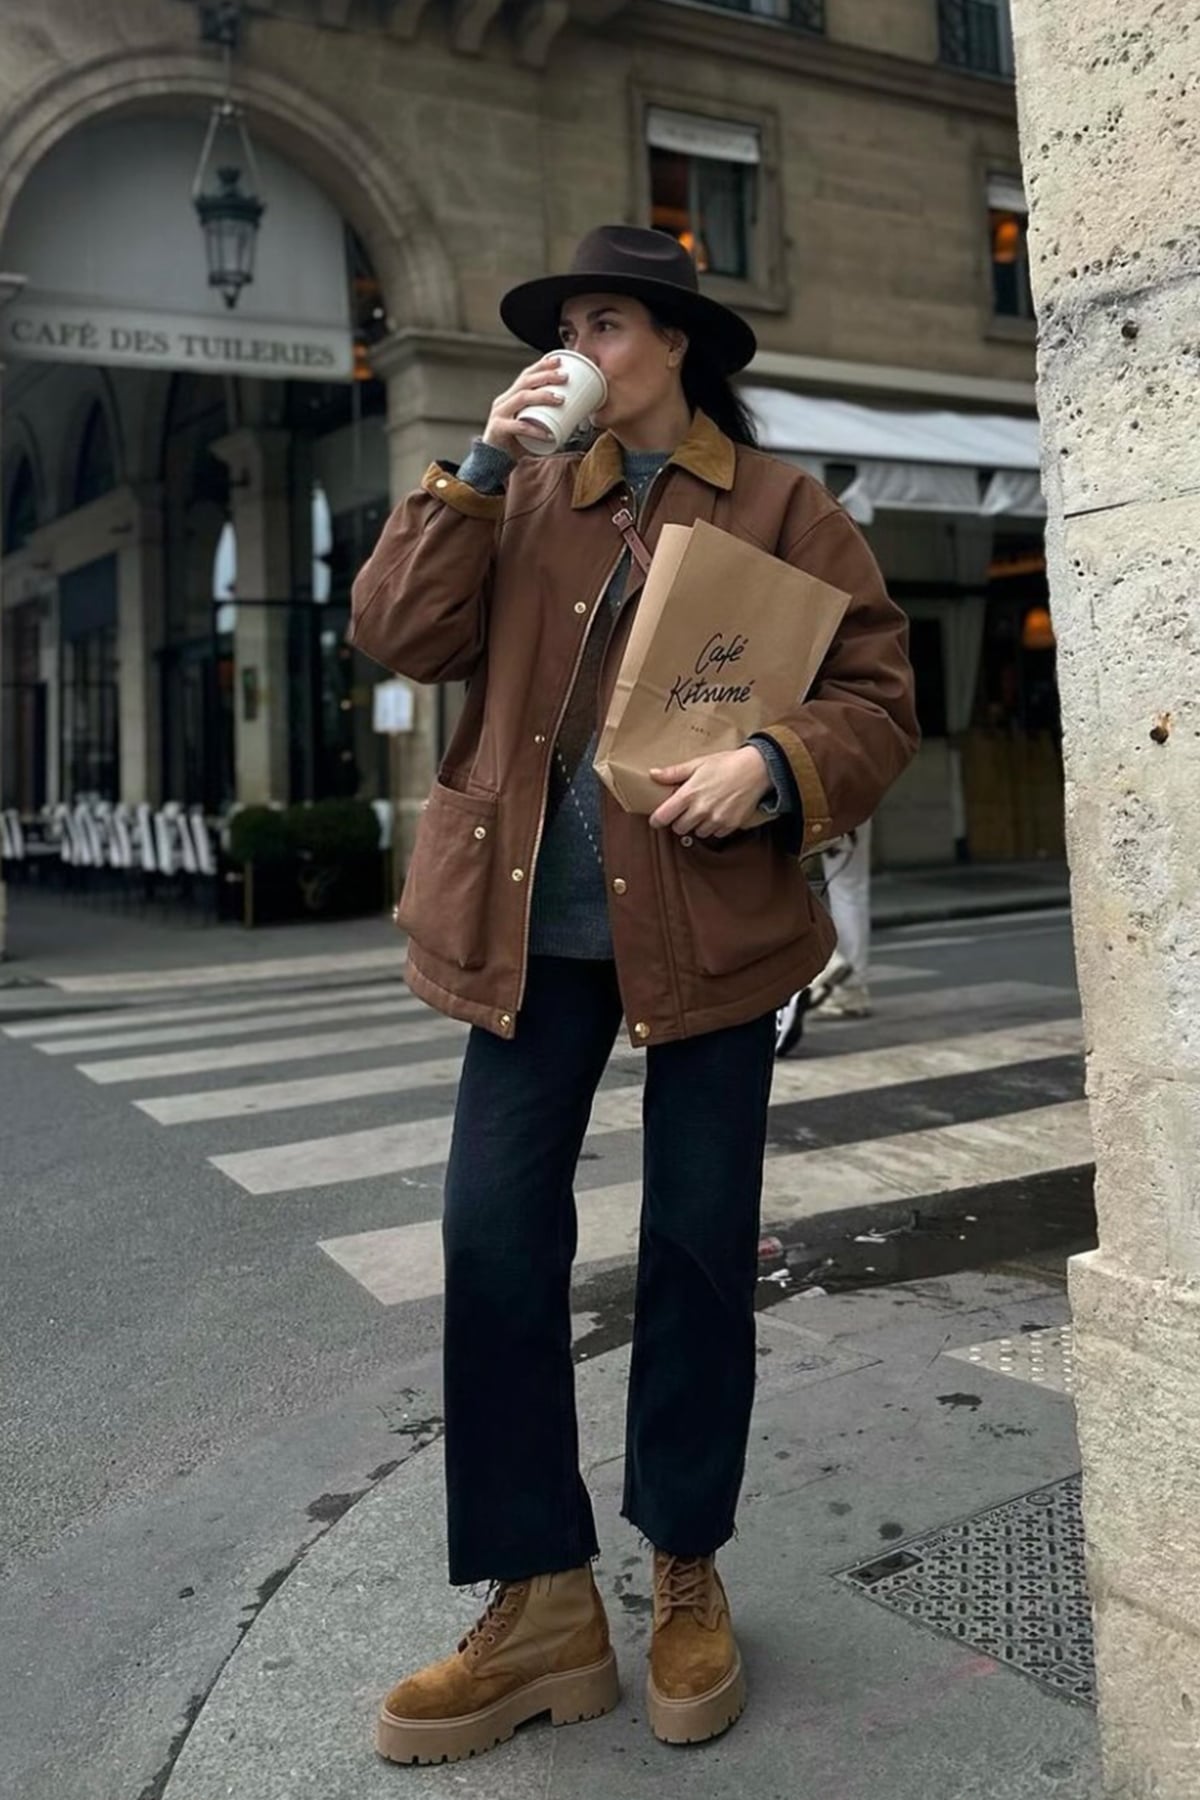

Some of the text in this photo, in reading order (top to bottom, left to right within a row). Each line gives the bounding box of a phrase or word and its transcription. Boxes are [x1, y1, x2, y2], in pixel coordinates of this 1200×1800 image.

[10, 319, 336, 367] CAFÉ DES TUILERIES
[695, 632, 749, 675] Café
[664, 675, 756, 713] Kitsuné
